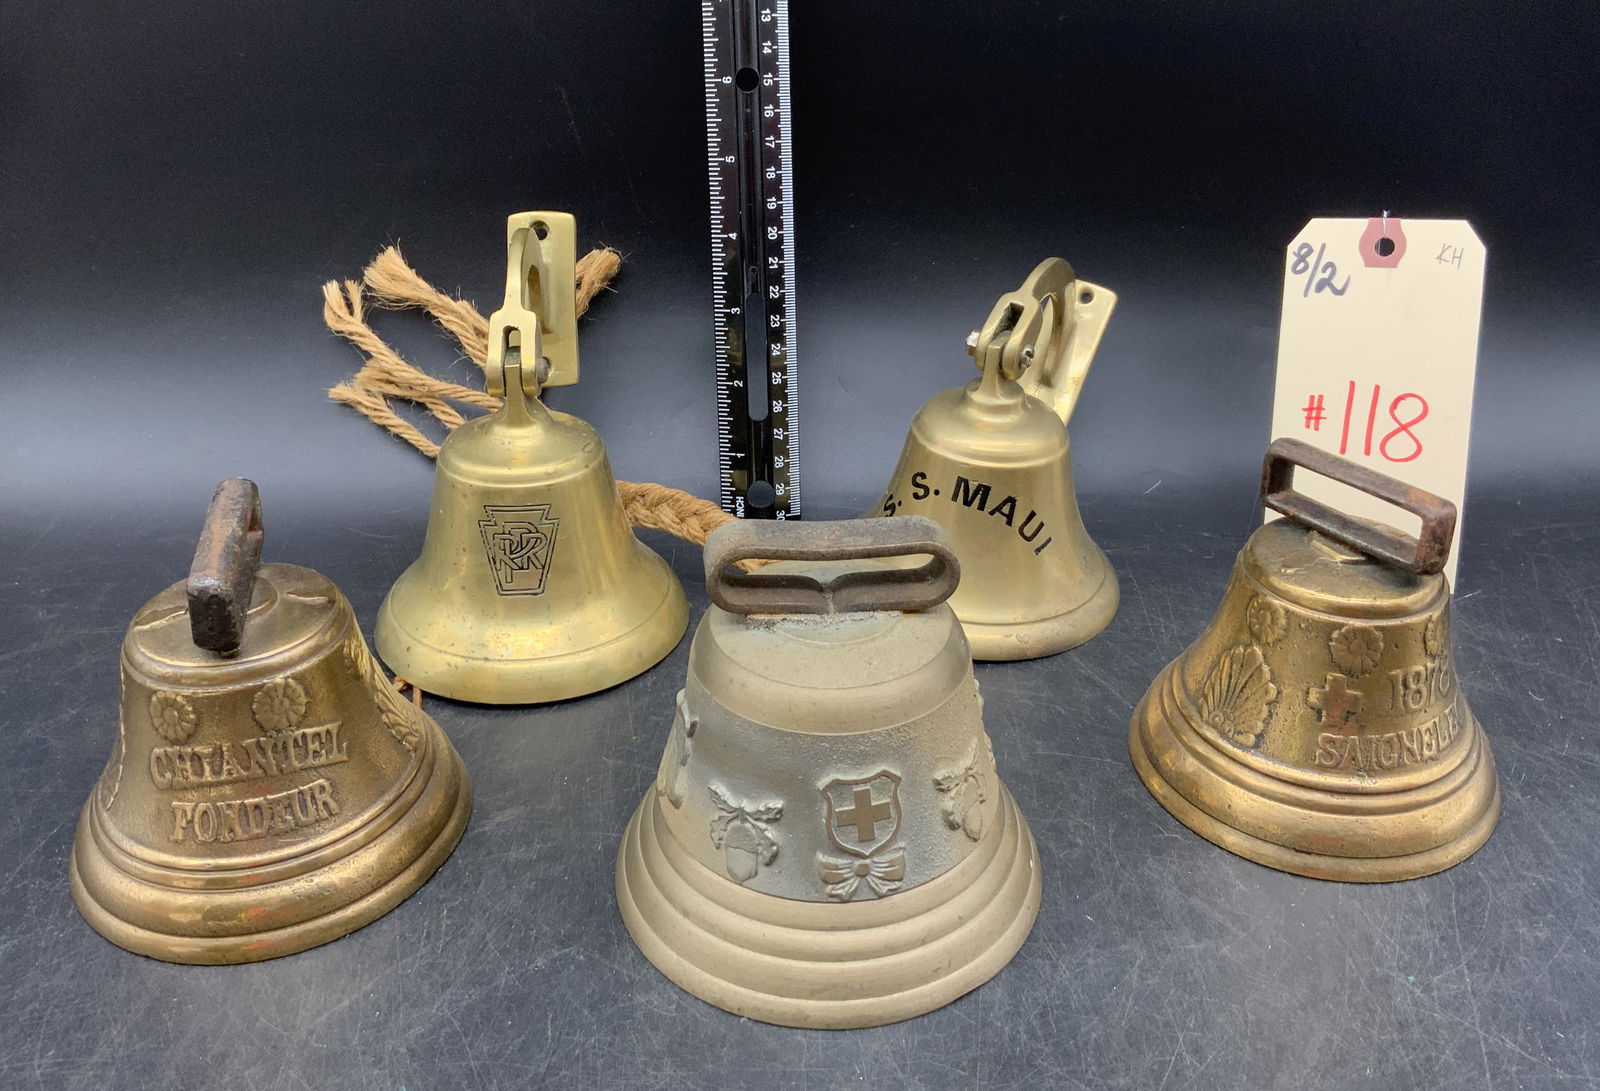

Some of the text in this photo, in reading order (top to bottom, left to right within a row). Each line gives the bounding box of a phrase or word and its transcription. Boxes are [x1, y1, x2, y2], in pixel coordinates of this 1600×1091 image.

[722, 76, 732, 84] 6
[725, 155, 735, 164] 5
[728, 232, 738, 240] 4
[761, 8, 786, 521] 13 14 15 16 17 18 19 20 21 22 23 24 25 26 27 28 29 30
[1435, 243, 1465, 271] KH
[1290, 242, 1351, 298] 8/2
[731, 307, 741, 315] 3
[733, 380, 743, 388] 2
[1302, 380, 1429, 463] #118
[735, 496, 745, 519] INCH
[951, 475, 1052, 556] MAUI
[170, 778, 341, 843] FONDEUR
